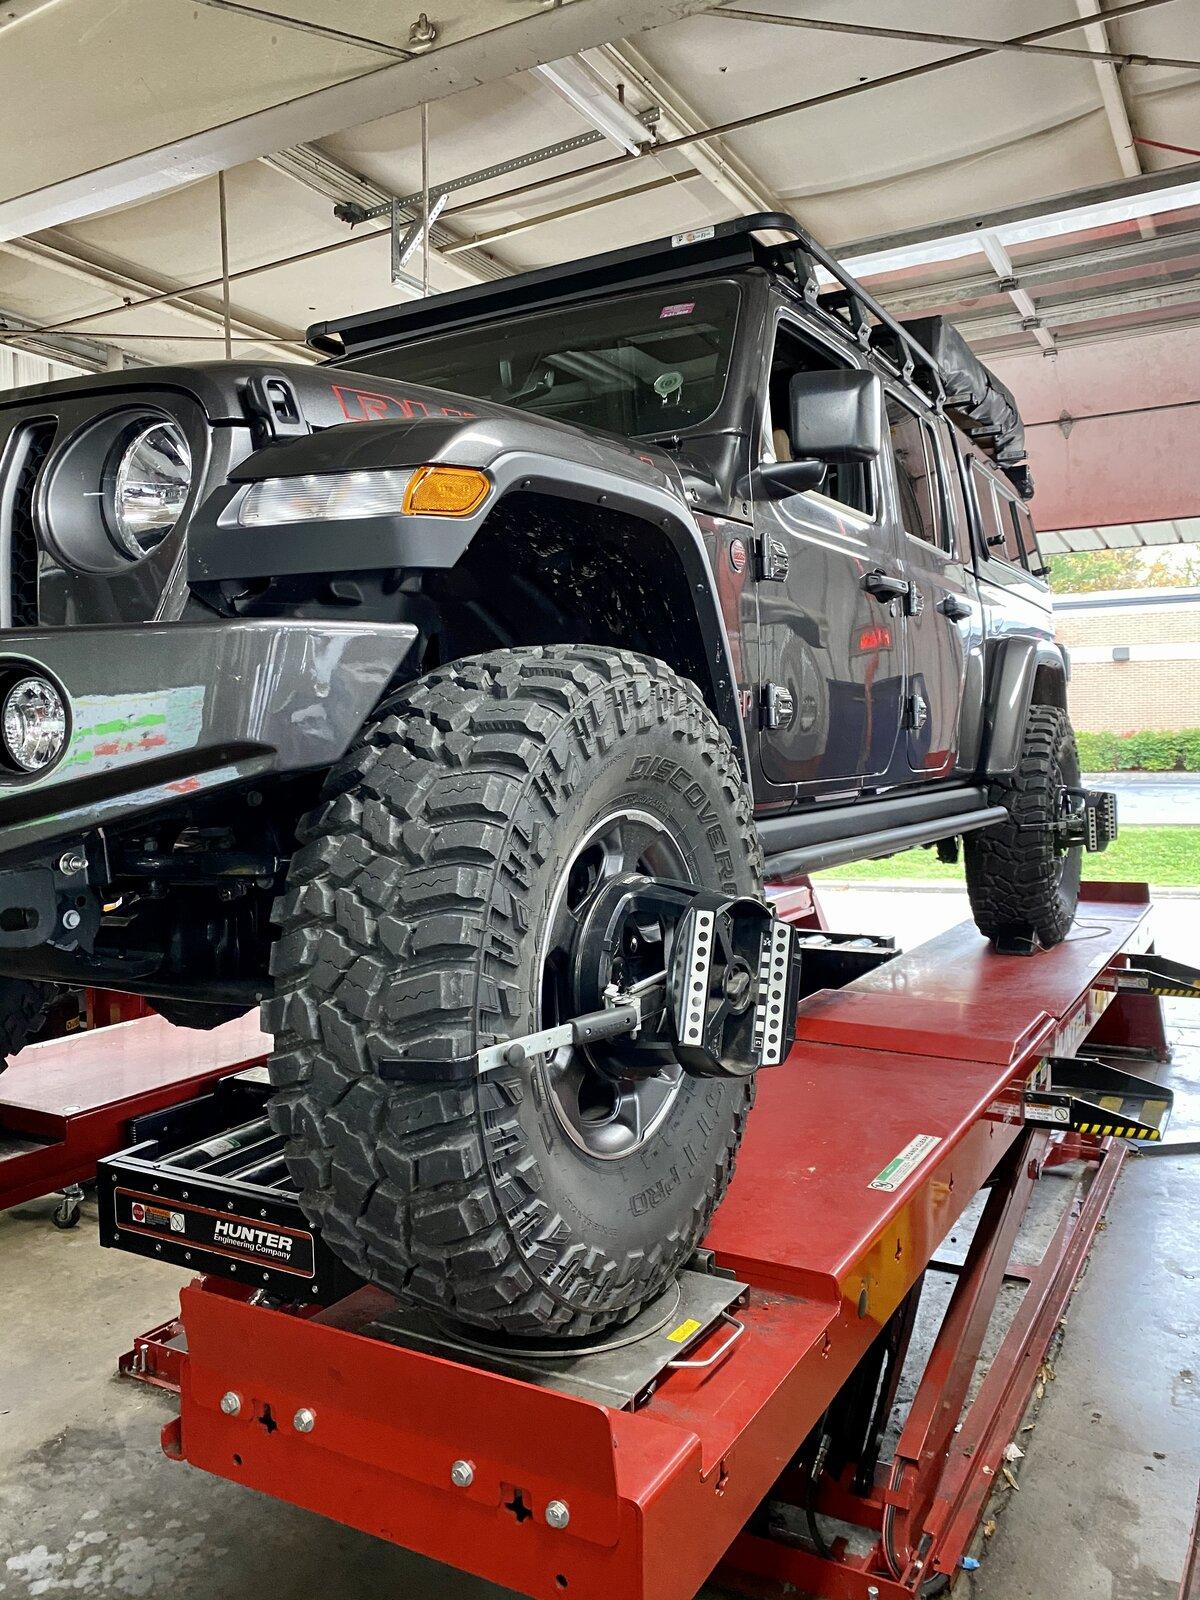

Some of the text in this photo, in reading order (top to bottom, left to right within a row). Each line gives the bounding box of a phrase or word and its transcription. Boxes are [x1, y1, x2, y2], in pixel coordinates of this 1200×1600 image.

[626, 753, 739, 896] DISCOVER
[213, 1233, 292, 1261] Engineering Company
[214, 1220, 293, 1252] HUNTER
